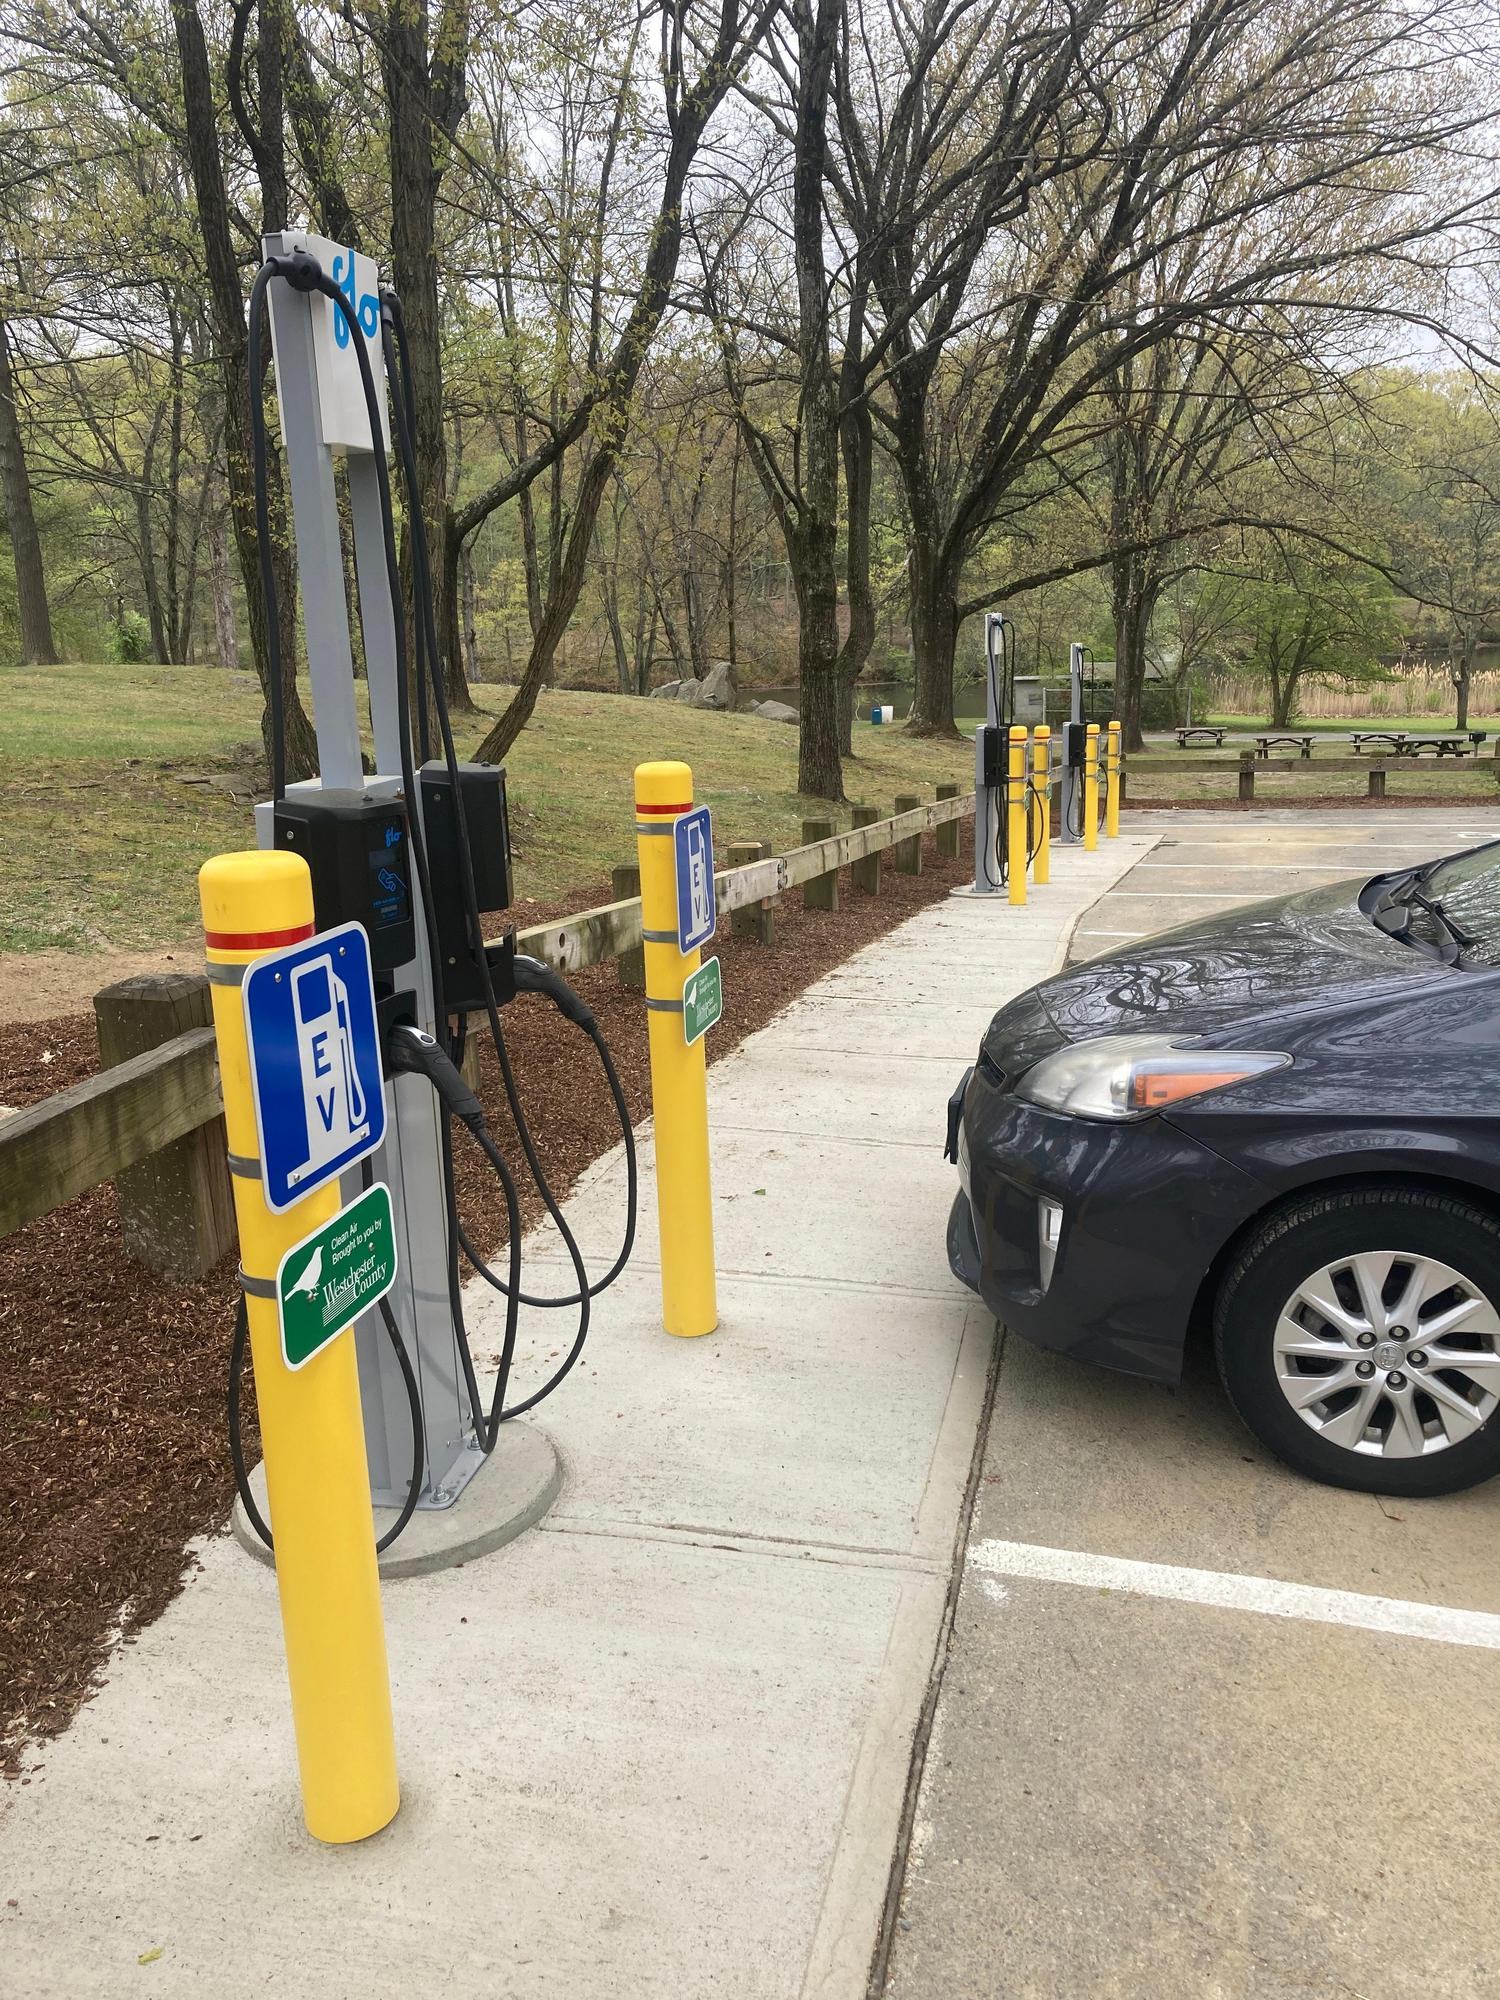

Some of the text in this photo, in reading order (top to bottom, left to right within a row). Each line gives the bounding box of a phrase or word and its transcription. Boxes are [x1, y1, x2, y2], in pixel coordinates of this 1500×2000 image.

[385, 826, 402, 848] flo
[331, 1222, 358, 1250] Clean Air
[332, 1217, 383, 1265] Brought to you by
[322, 1254, 376, 1306] Westchester
[353, 1261, 387, 1299] County
